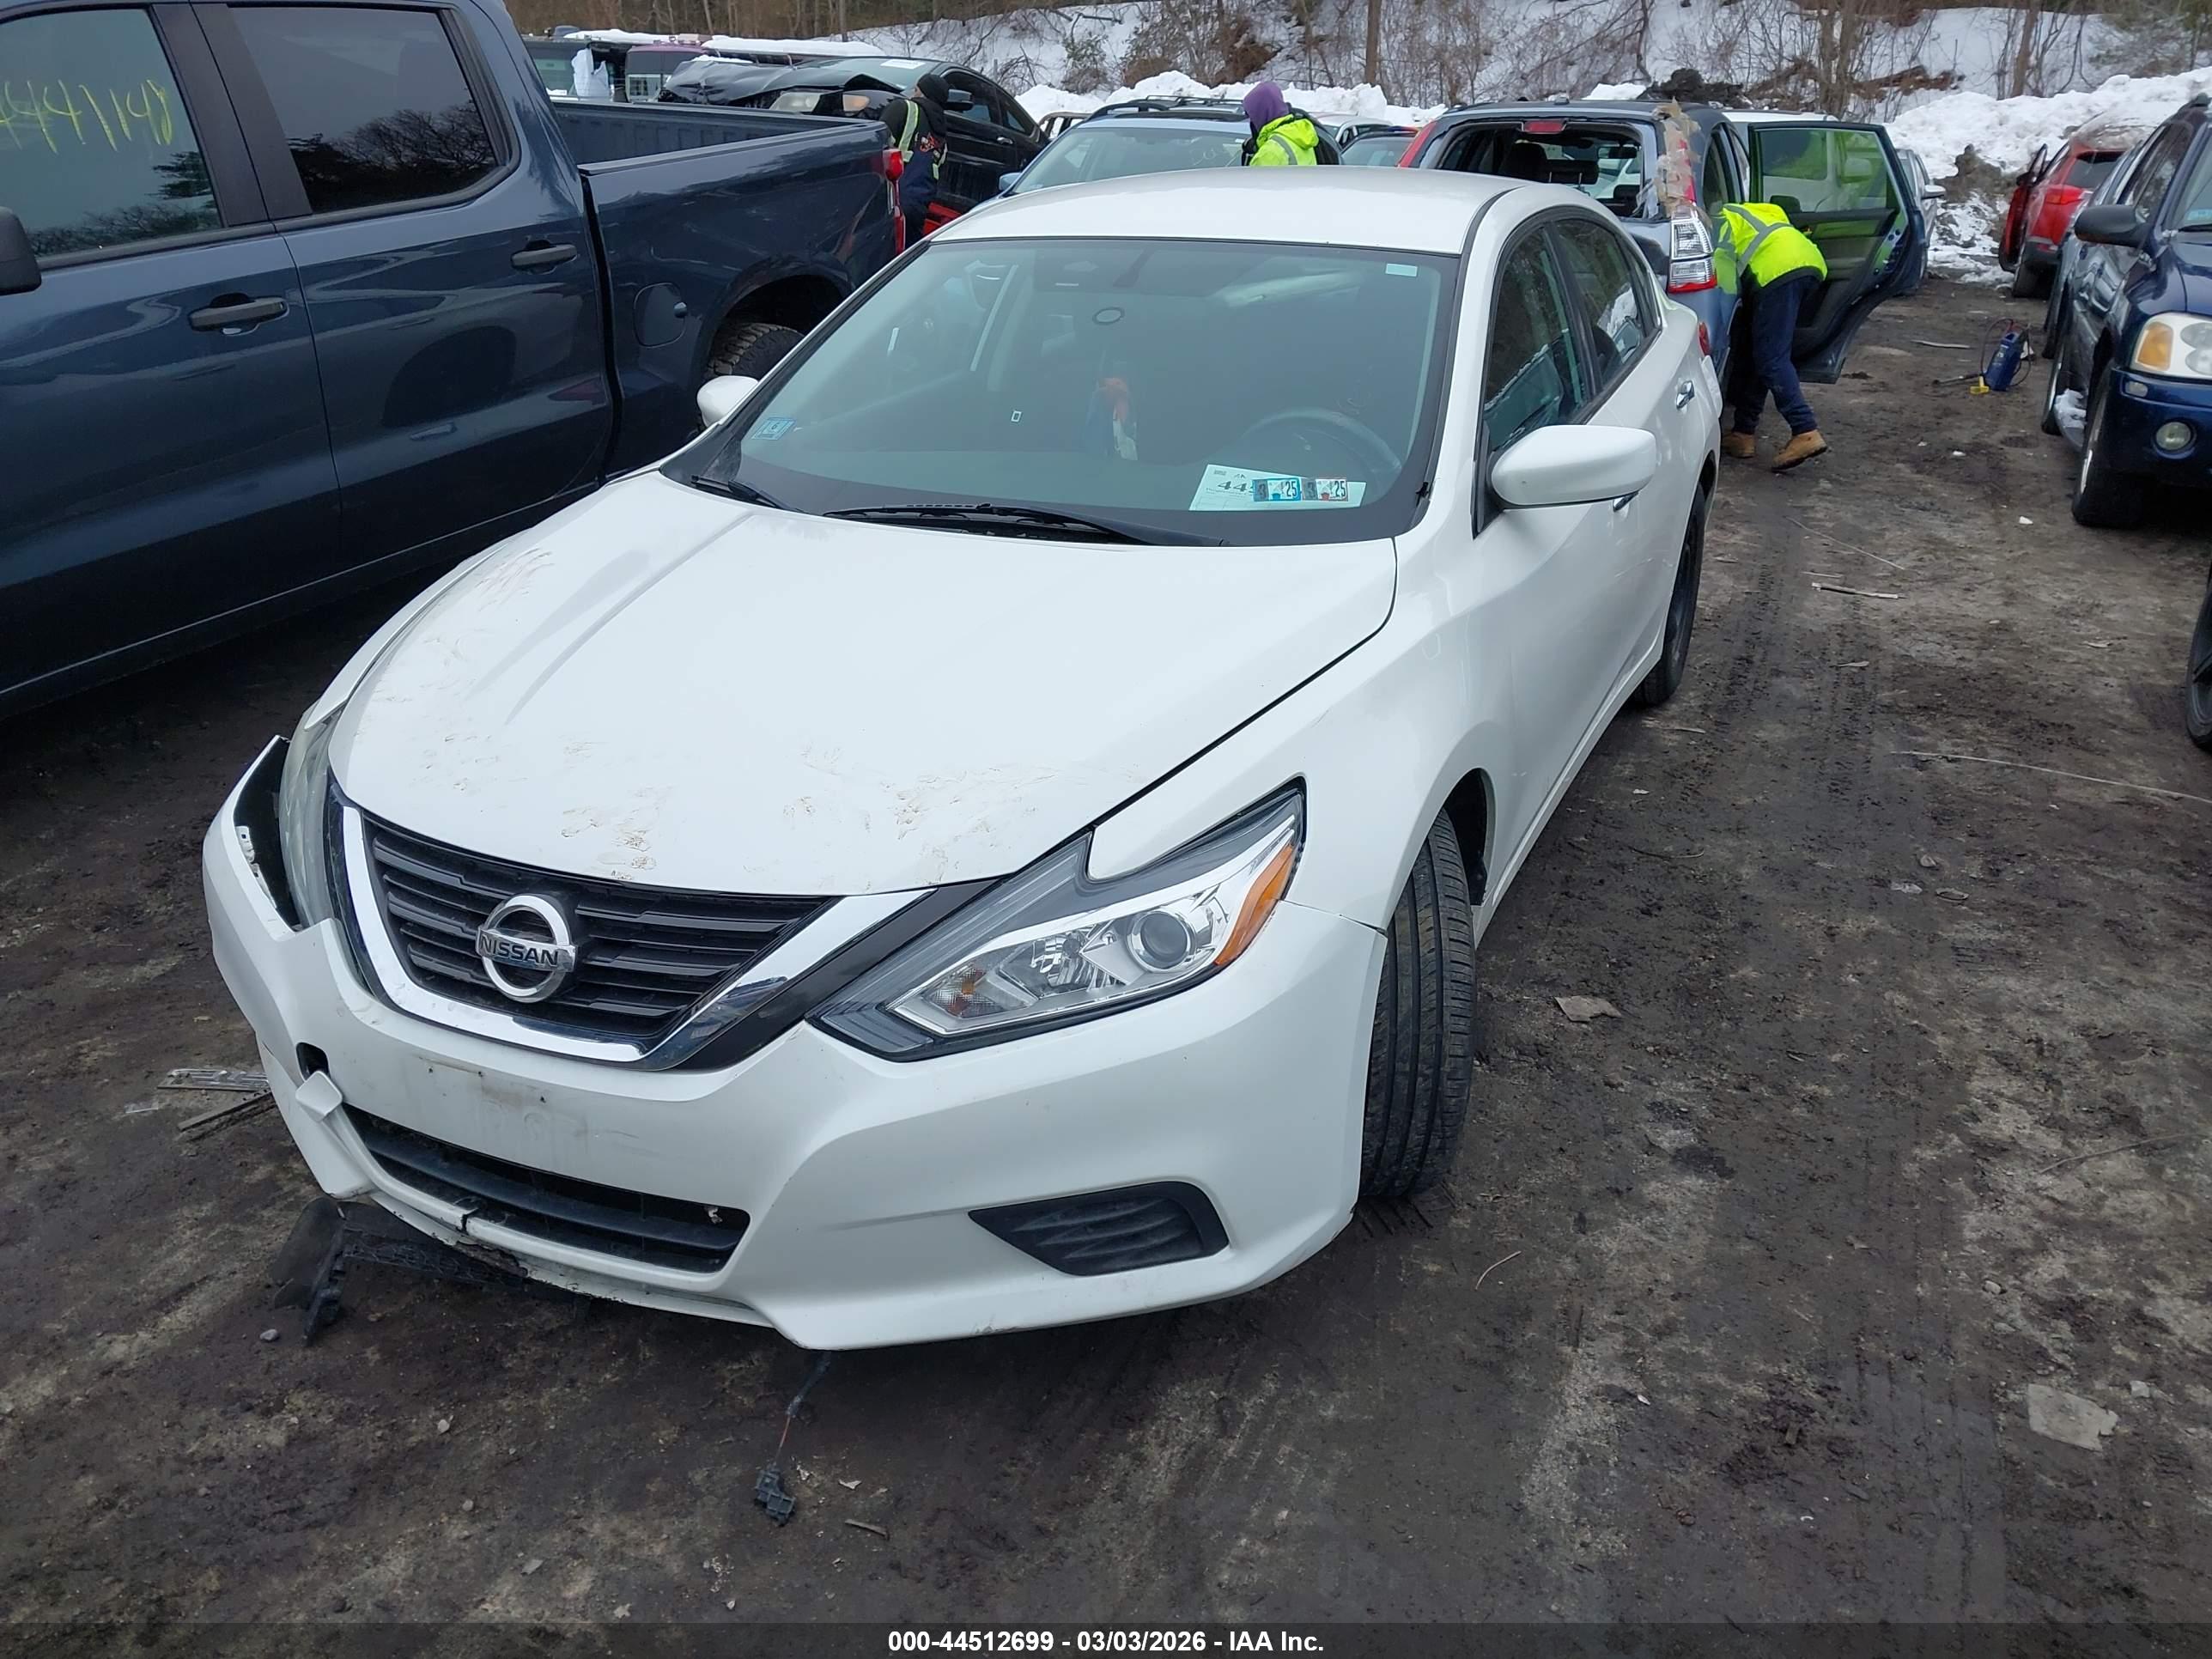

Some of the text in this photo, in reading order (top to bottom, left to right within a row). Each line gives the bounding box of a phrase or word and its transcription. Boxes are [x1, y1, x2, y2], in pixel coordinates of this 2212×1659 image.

[1285, 480, 1297, 497] 25
[1334, 480, 1346, 497] 25
[480, 934, 558, 967] NISSAN
